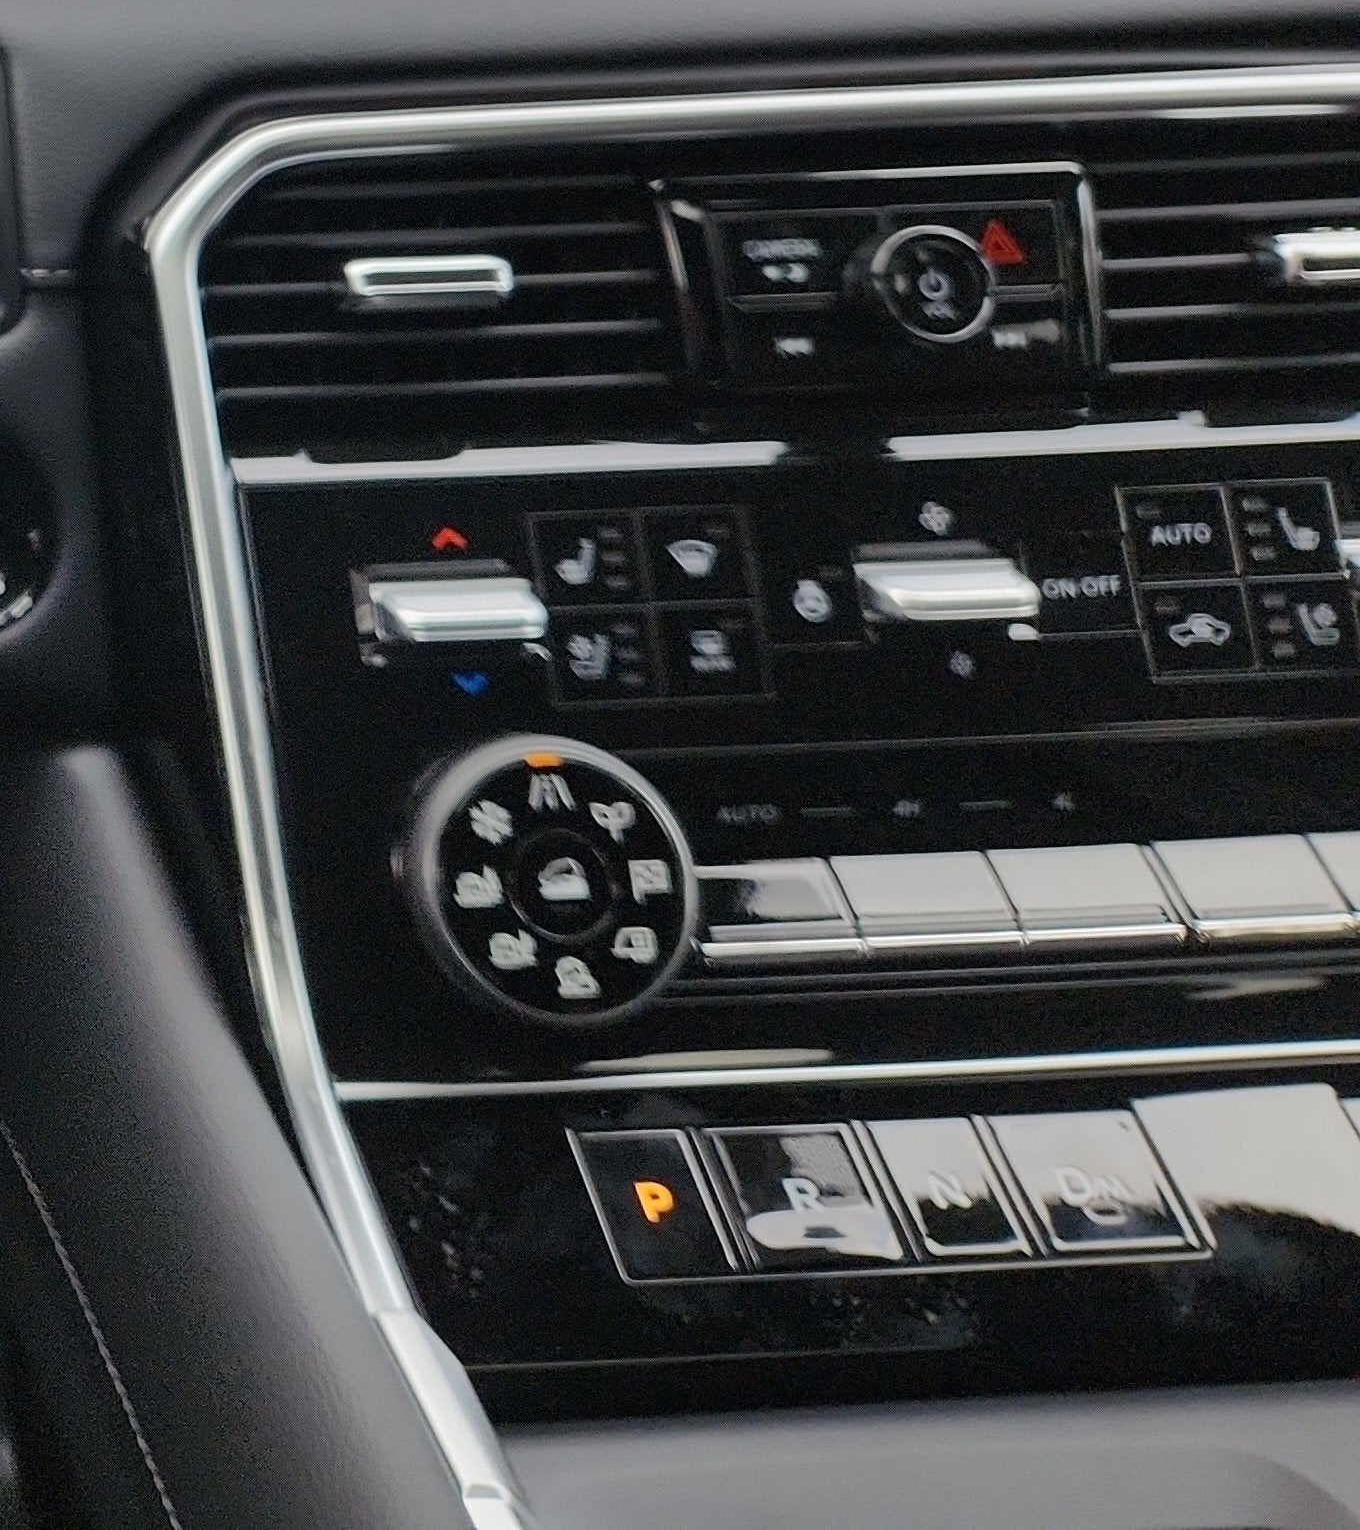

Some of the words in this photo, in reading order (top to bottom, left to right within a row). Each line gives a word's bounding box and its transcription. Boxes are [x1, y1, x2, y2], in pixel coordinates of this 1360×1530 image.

[1150, 522, 1213, 547] AUTO
[633, 1181, 675, 1224] P
[782, 1178, 827, 1214] R
[928, 1171, 973, 1210] N
